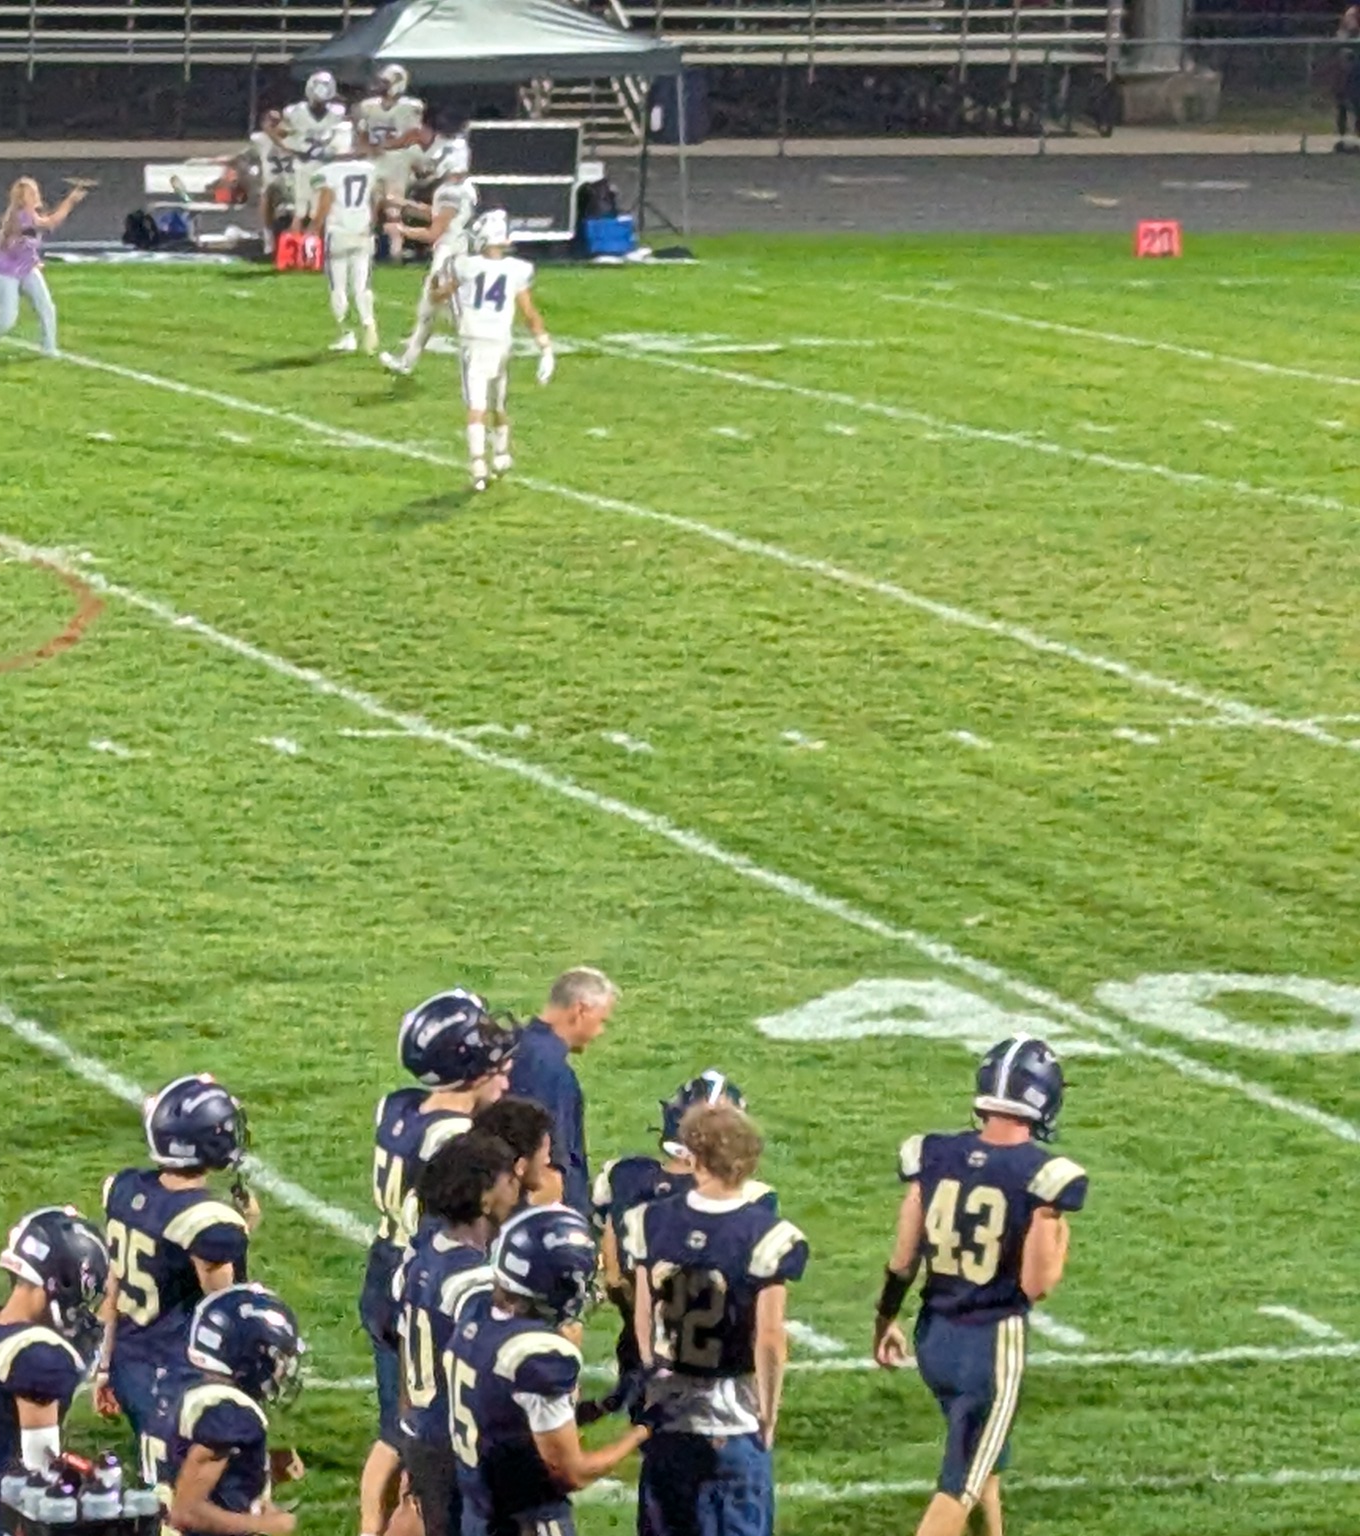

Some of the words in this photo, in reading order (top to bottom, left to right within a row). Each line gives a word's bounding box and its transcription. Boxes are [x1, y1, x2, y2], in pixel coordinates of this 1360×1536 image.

[343, 174, 368, 209] 17
[474, 272, 507, 312] 14
[923, 1179, 1009, 1287] 43
[443, 1350, 480, 1469] 15
